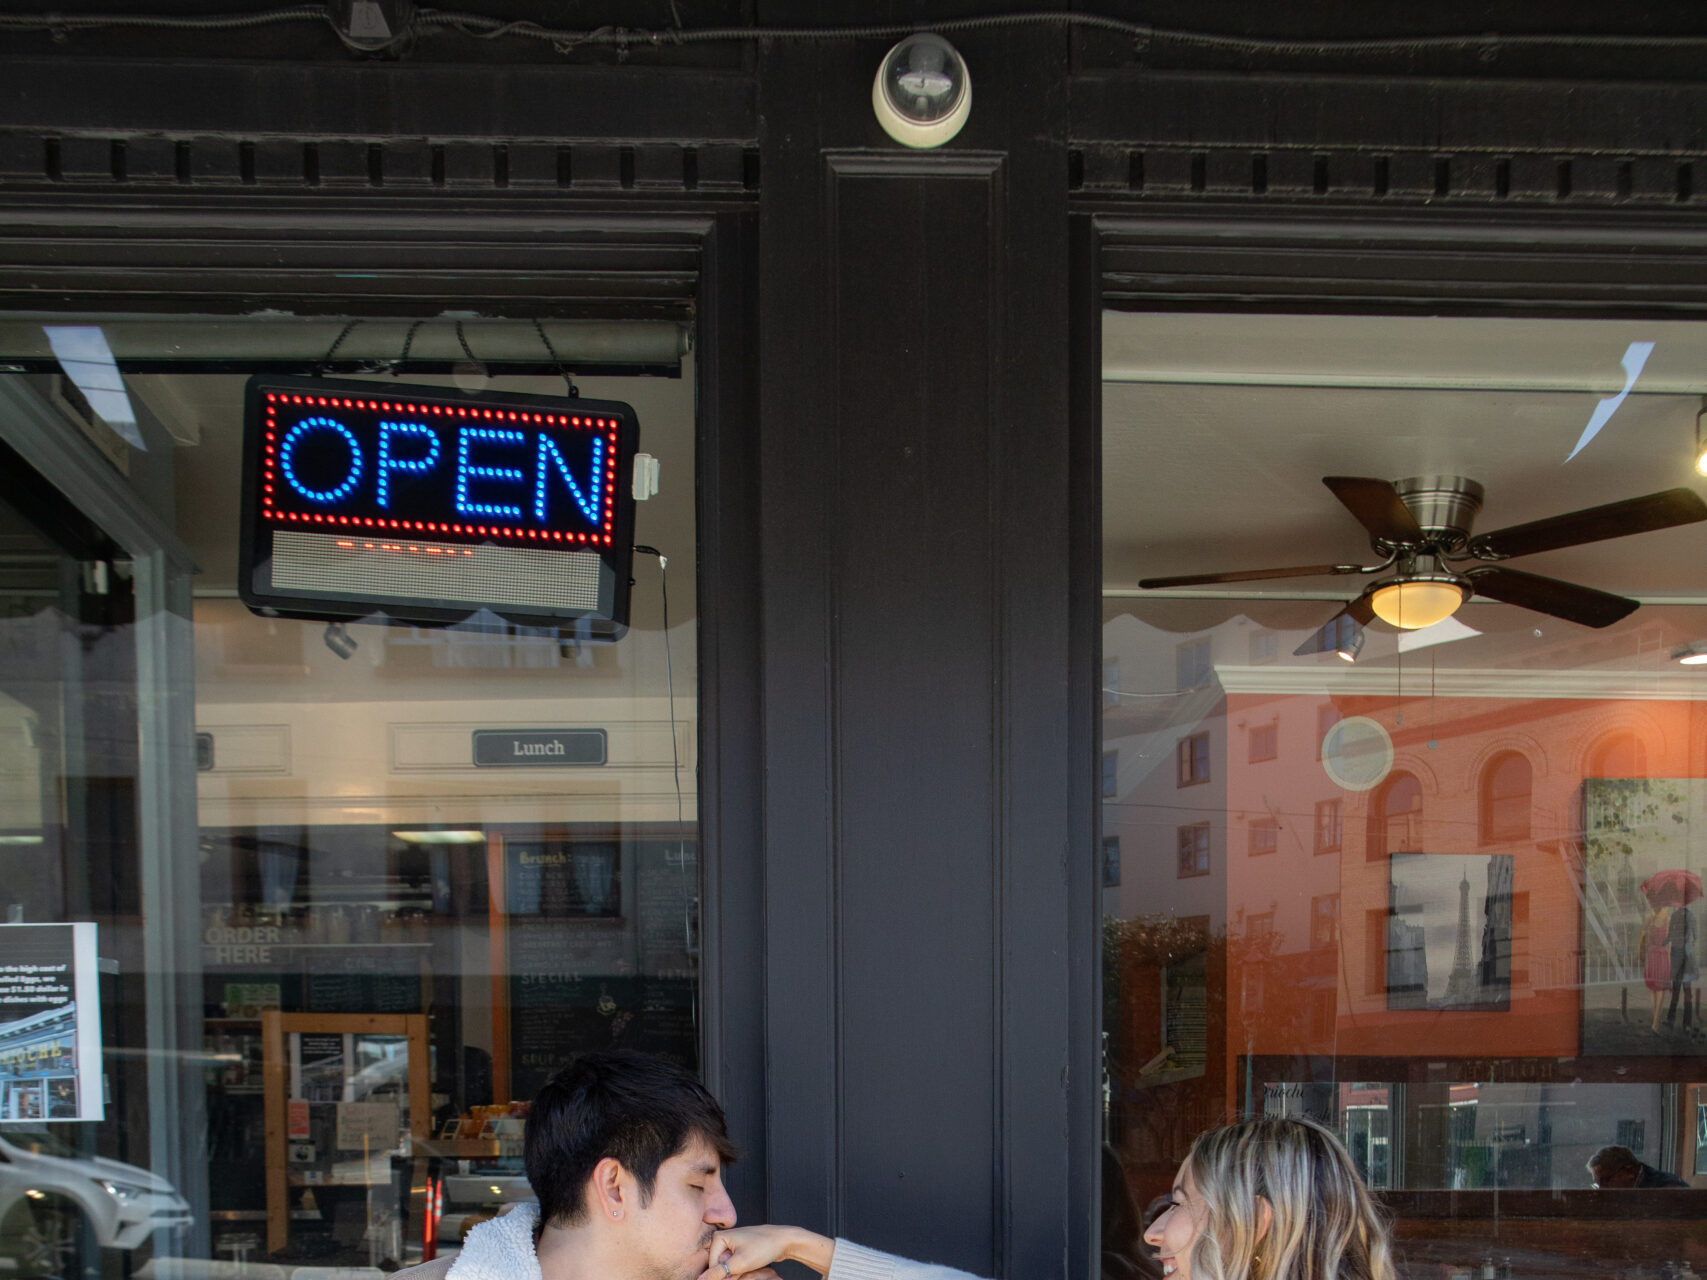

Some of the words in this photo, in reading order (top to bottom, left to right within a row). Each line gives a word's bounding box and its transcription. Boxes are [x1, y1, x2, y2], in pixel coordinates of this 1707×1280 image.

[281, 416, 602, 523] OPEN
[513, 740, 565, 756] Lunch
[206, 927, 280, 944] ORDER
[216, 945, 272, 963] HERE
